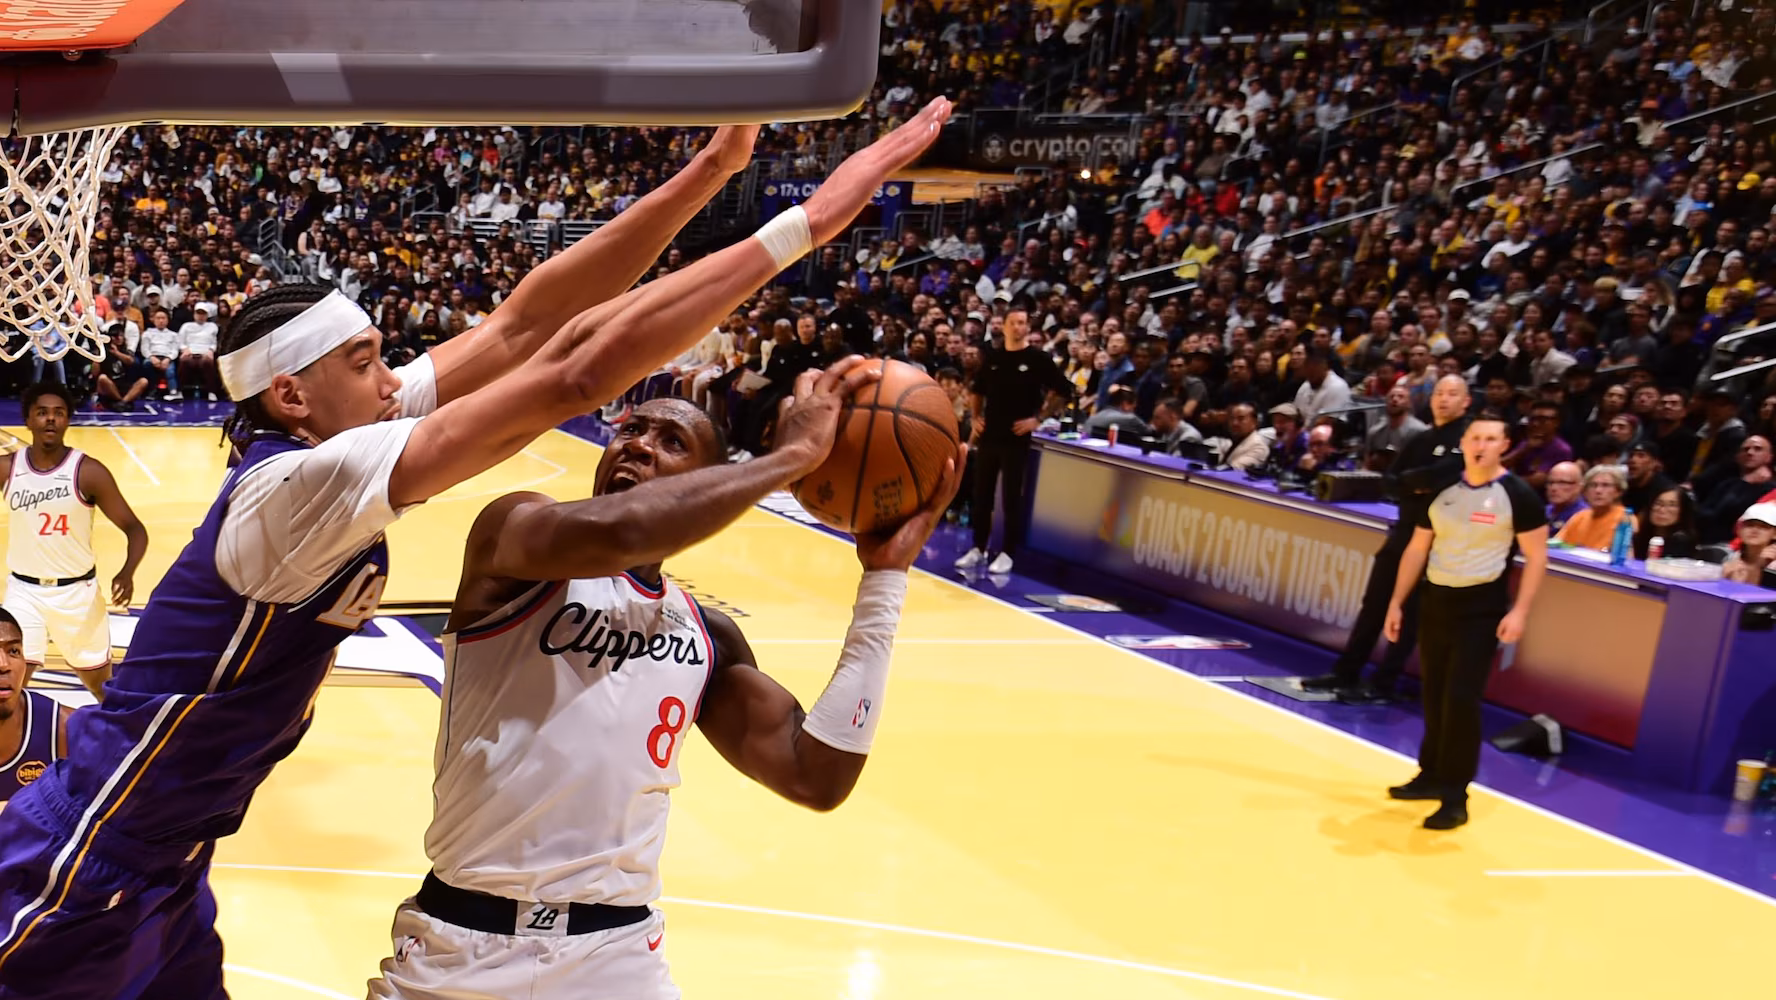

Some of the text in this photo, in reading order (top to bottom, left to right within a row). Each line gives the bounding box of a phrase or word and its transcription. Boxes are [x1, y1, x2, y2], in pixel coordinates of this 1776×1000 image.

[10, 484, 71, 512] Clippers
[38, 512, 70, 537] 24
[1132, 496, 1204, 580] COAST
[1195, 511, 1217, 586] 2
[1210, 515, 1290, 608] COAST
[539, 601, 705, 673] Clippers
[646, 695, 686, 769] 8
[526, 906, 560, 930] LA
